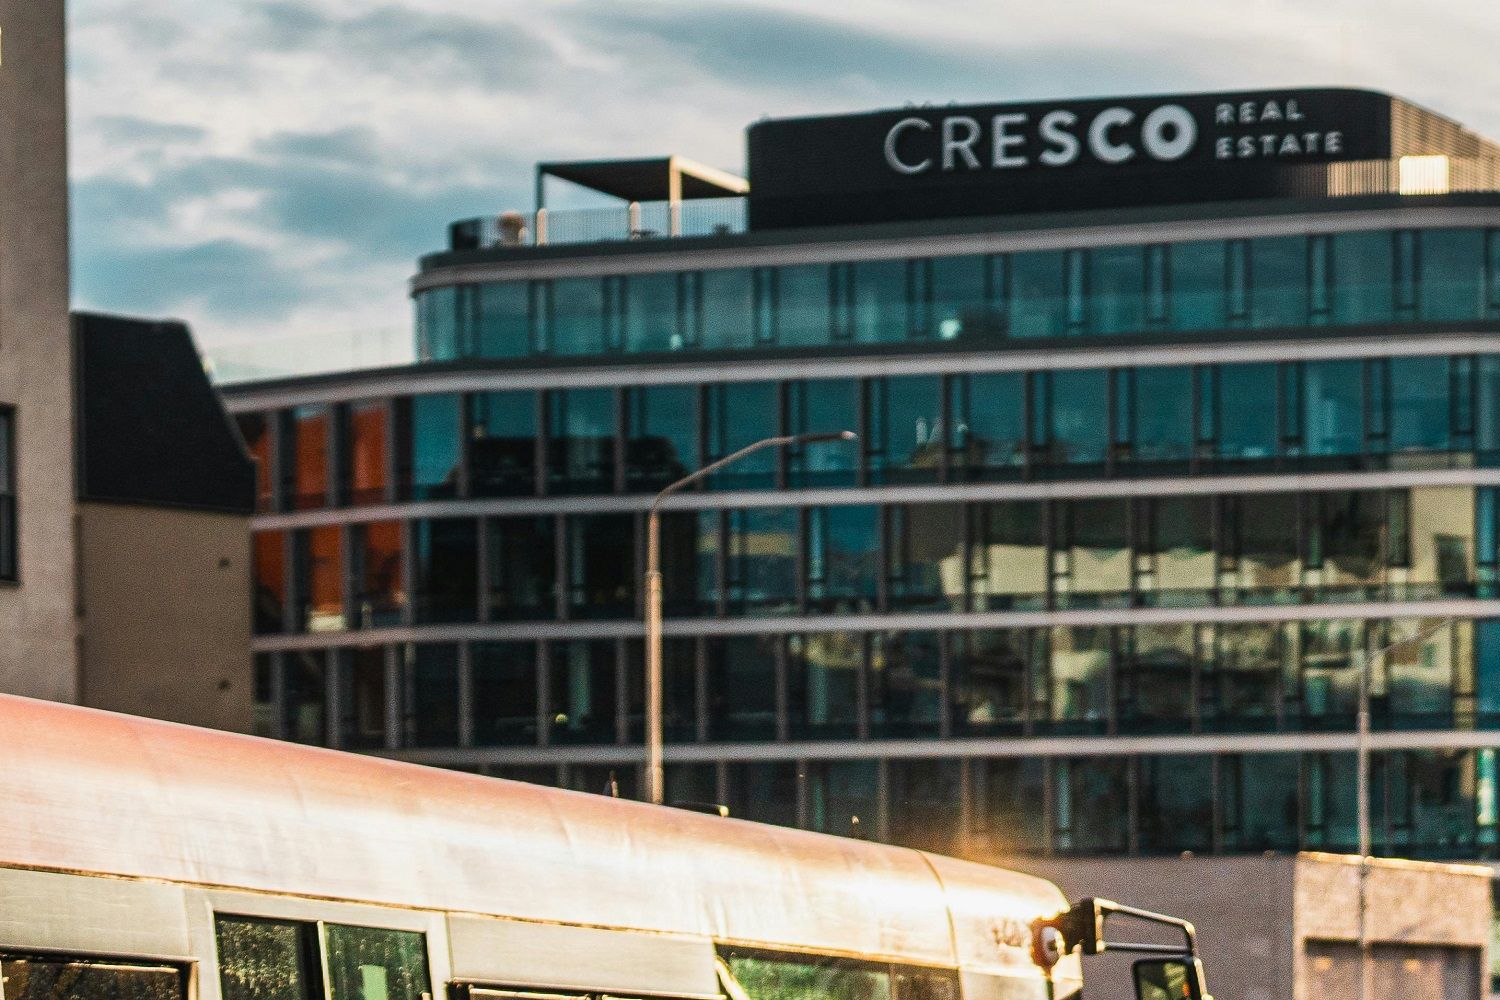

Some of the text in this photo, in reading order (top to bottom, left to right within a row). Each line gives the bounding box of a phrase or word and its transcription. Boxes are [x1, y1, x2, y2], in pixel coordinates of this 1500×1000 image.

[1214, 99, 1304, 124] REAL
[884, 104, 1198, 174] CRESCO
[1215, 131, 1344, 160] ESTATE
